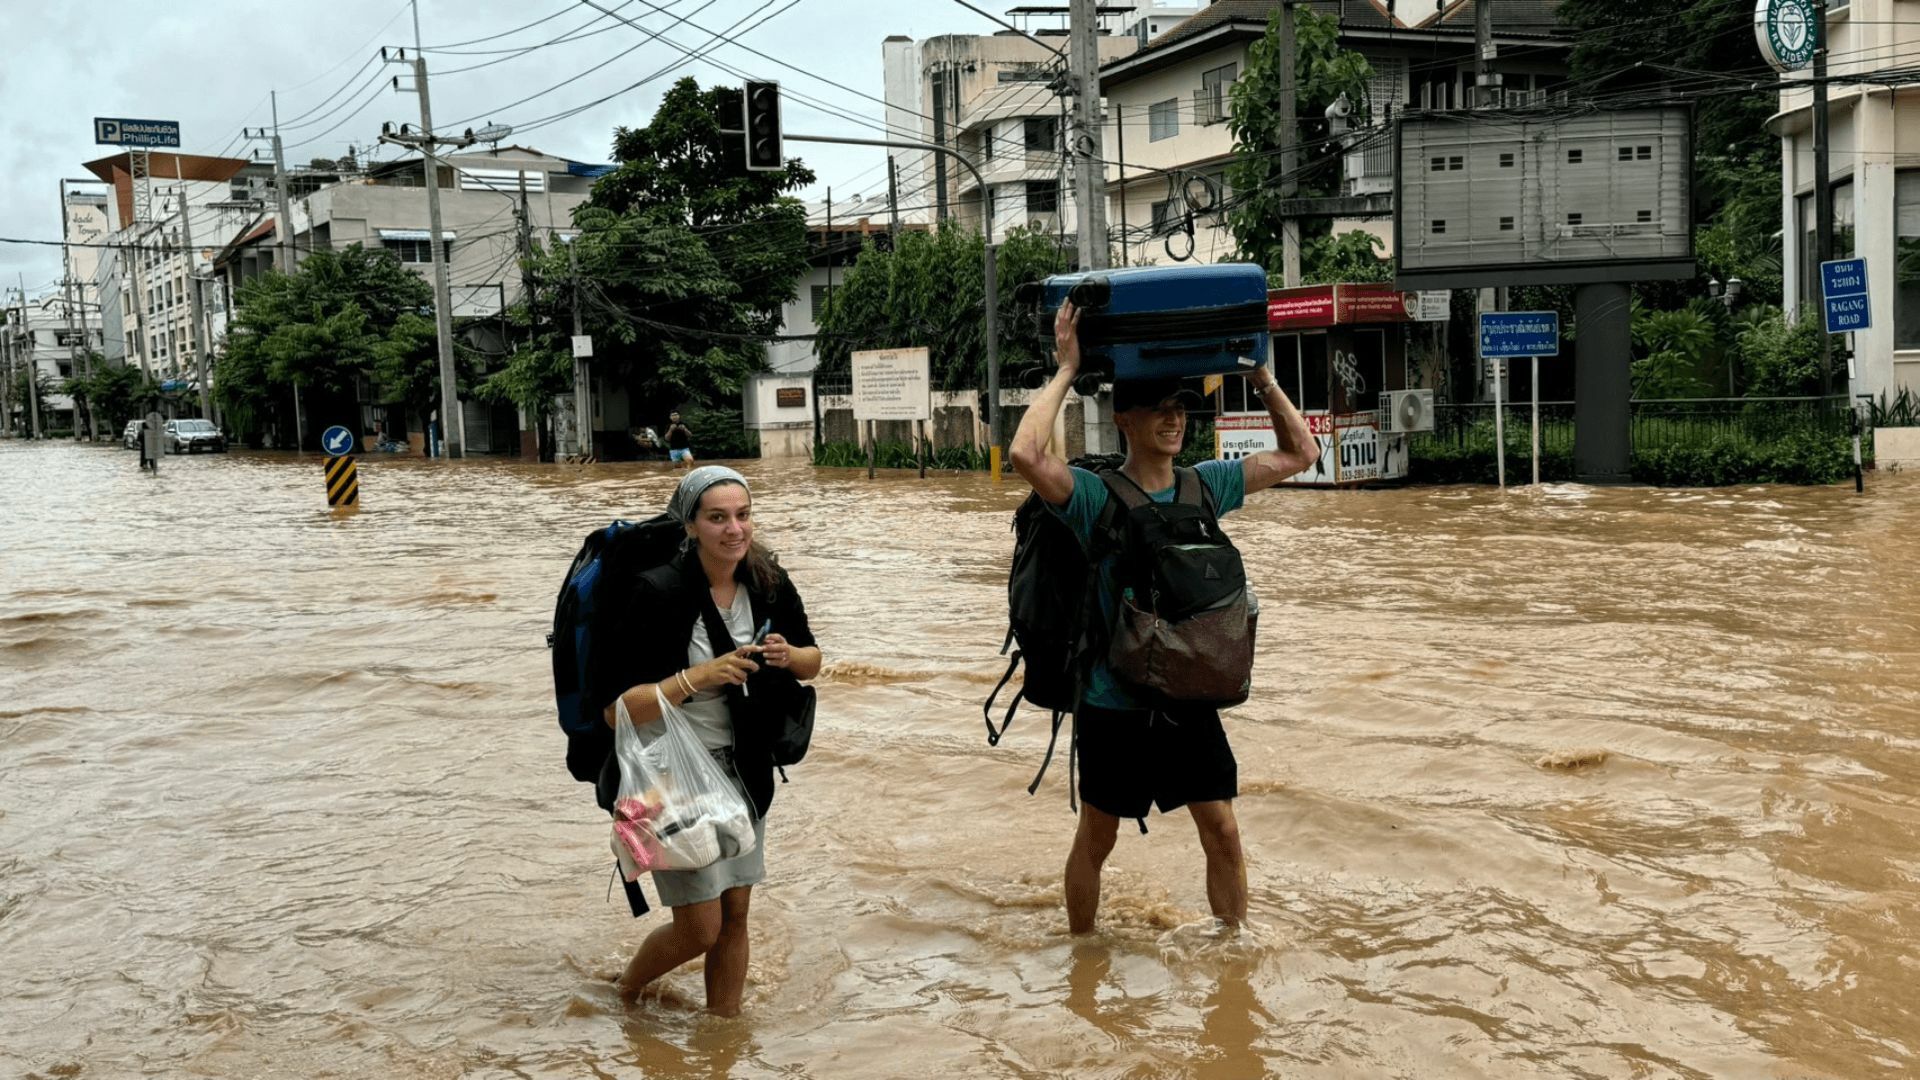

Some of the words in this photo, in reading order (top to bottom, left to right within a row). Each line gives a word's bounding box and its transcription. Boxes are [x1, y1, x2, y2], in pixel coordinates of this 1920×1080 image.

[1771, 33, 1815, 62] RESIDENCE
[122, 133, 178, 145] PhillipLife
[1831, 299, 1864, 313] RAGANG
[1838, 313, 1860, 326] ROAD
